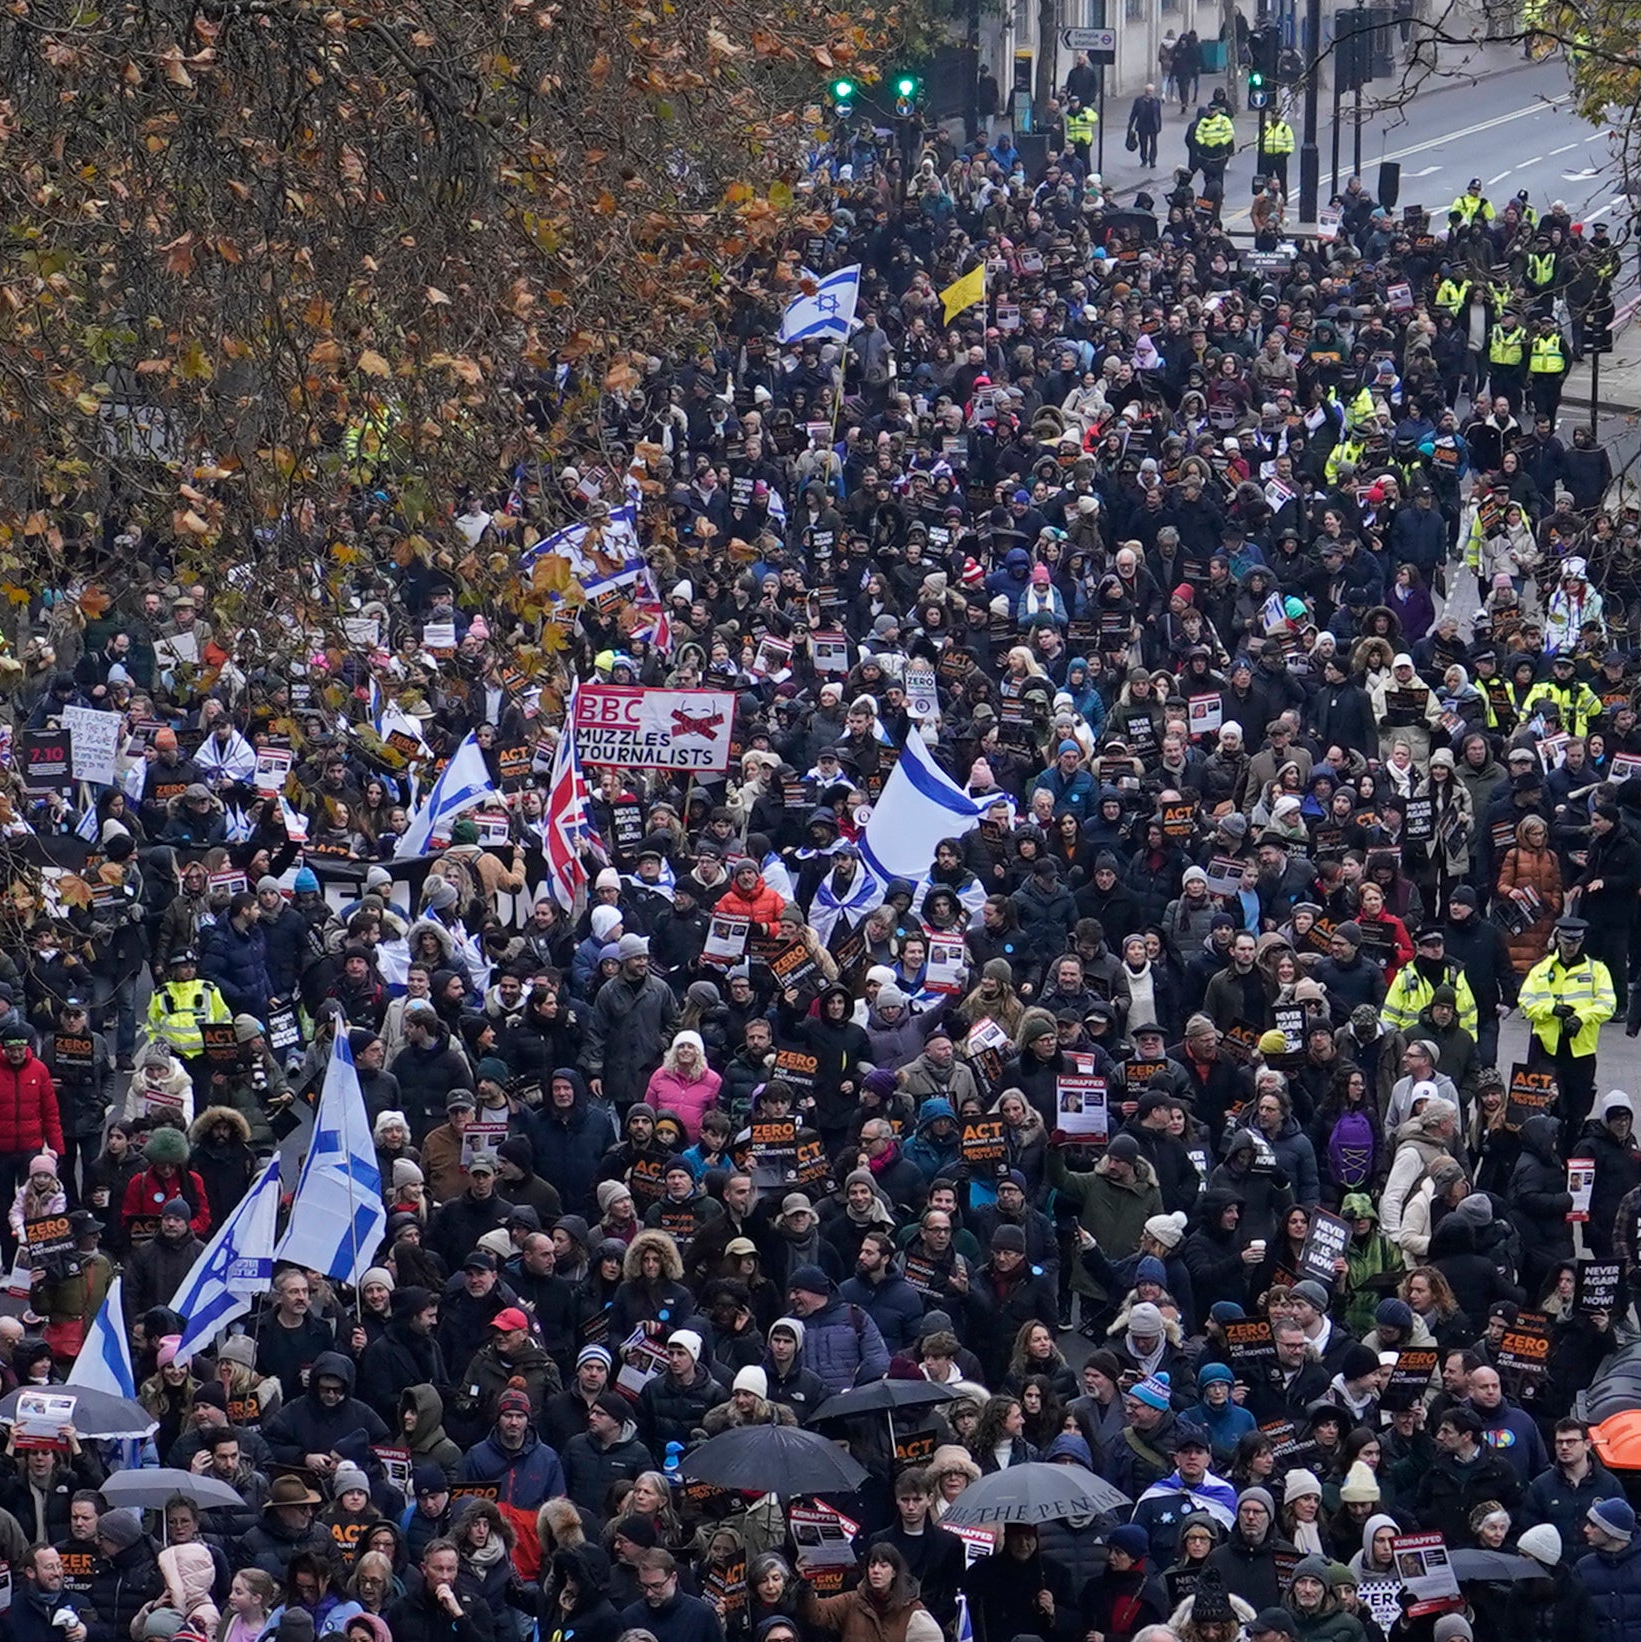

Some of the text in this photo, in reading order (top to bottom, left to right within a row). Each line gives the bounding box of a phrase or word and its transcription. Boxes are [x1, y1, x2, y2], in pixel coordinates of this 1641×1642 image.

[908, 678, 933, 688] ZERO
[578, 696, 644, 725] BBC
[576, 728, 671, 748] MUZZLES
[30, 748, 65, 763] 7.10
[576, 748, 713, 767] JOURNALISTS
[1406, 801, 1432, 811] NEVER
[1406, 810, 1432, 820] AGAIN
[205, 1030, 234, 1043] ACT
[56, 1037, 93, 1051] ZERO
[962, 1122, 1003, 1141] ACT
[27, 1218, 69, 1237] ZERO
[1316, 1218, 1346, 1239] NEVER
[1313, 1231, 1344, 1251] AGAIN
[1320, 1246, 1331, 1258] IS
[1585, 1266, 1620, 1277] NEVER
[1583, 1276, 1619, 1287] AGAIN
[1595, 1288, 1605, 1296] IS
[1225, 1321, 1271, 1338] ZERO
[791, 1510, 838, 1521] KIDNAPPED
[976, 1506, 1026, 1523] THE
[1393, 1536, 1442, 1549] KIDNAPPED
